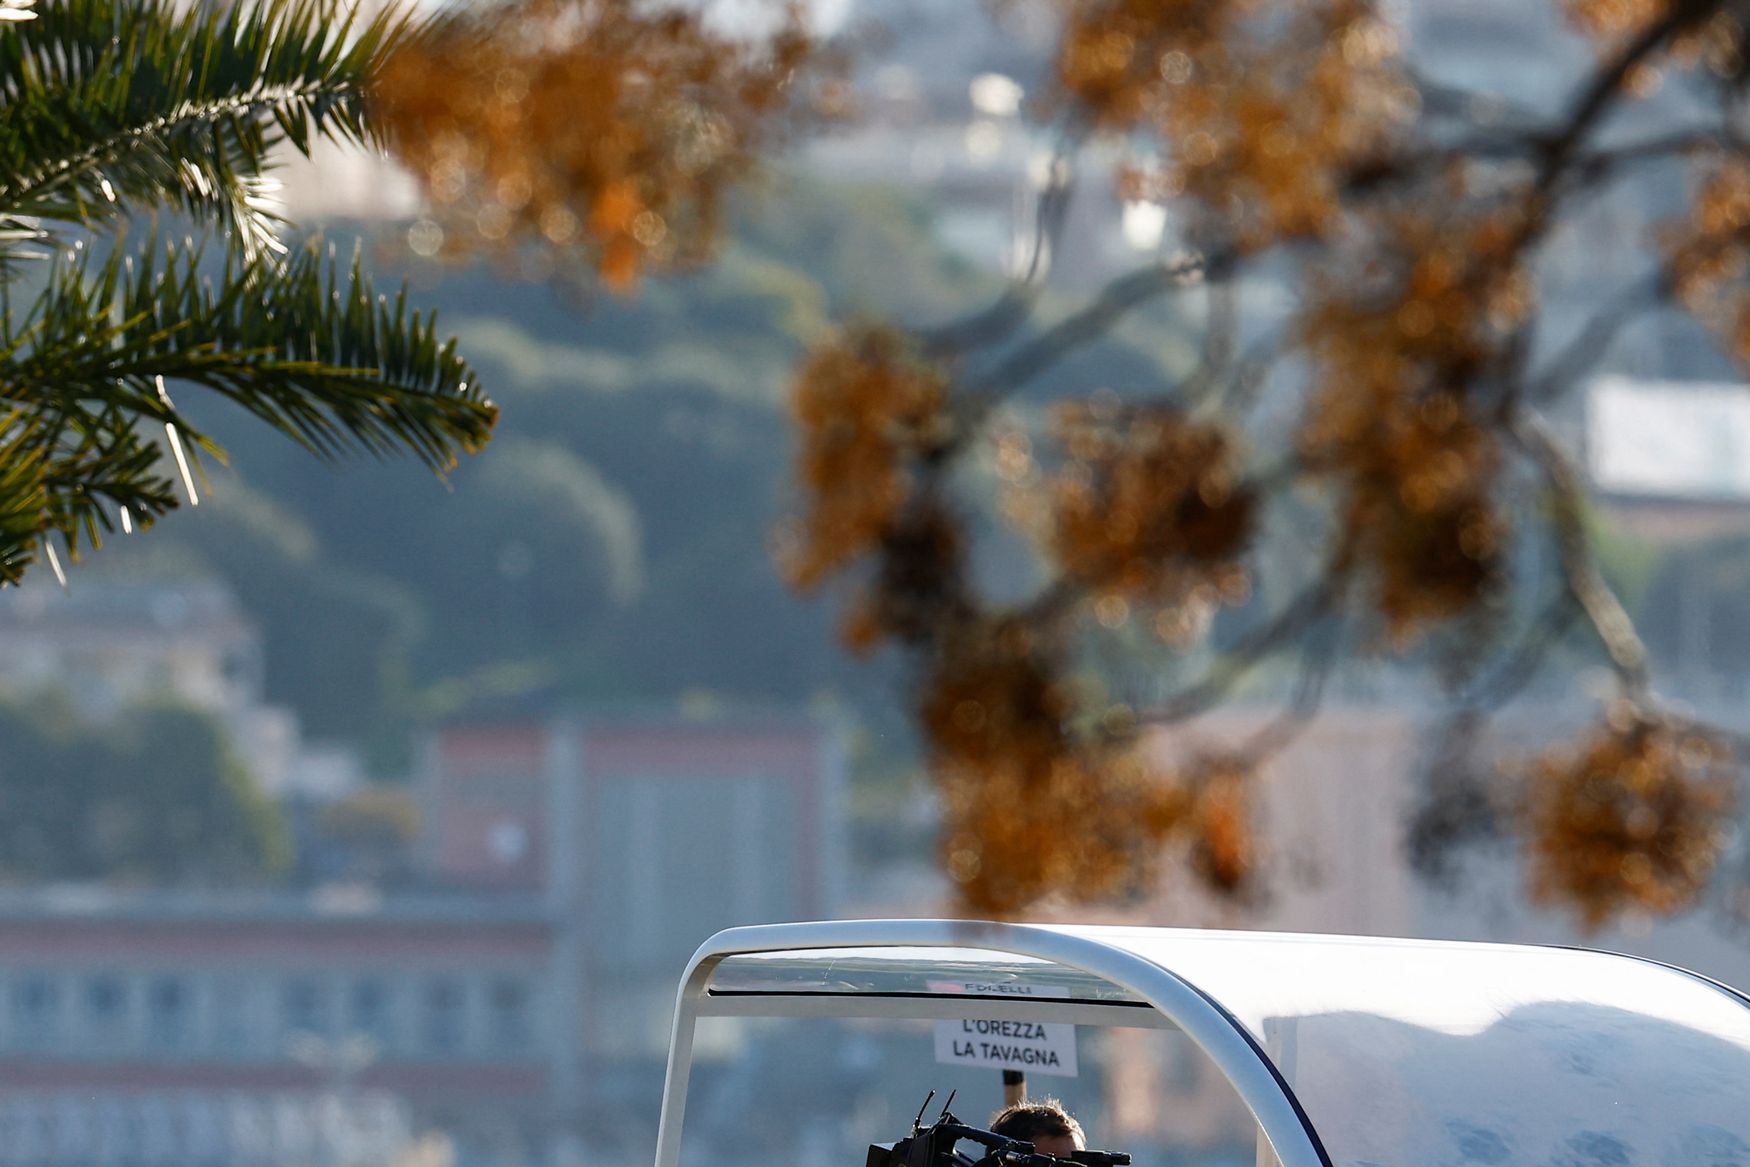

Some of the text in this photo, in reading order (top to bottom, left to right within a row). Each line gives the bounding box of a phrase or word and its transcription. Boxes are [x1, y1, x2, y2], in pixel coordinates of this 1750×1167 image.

[962, 1019, 1047, 1041] L'OREZZA
[952, 1040, 1061, 1068] LA TAVAGNA
